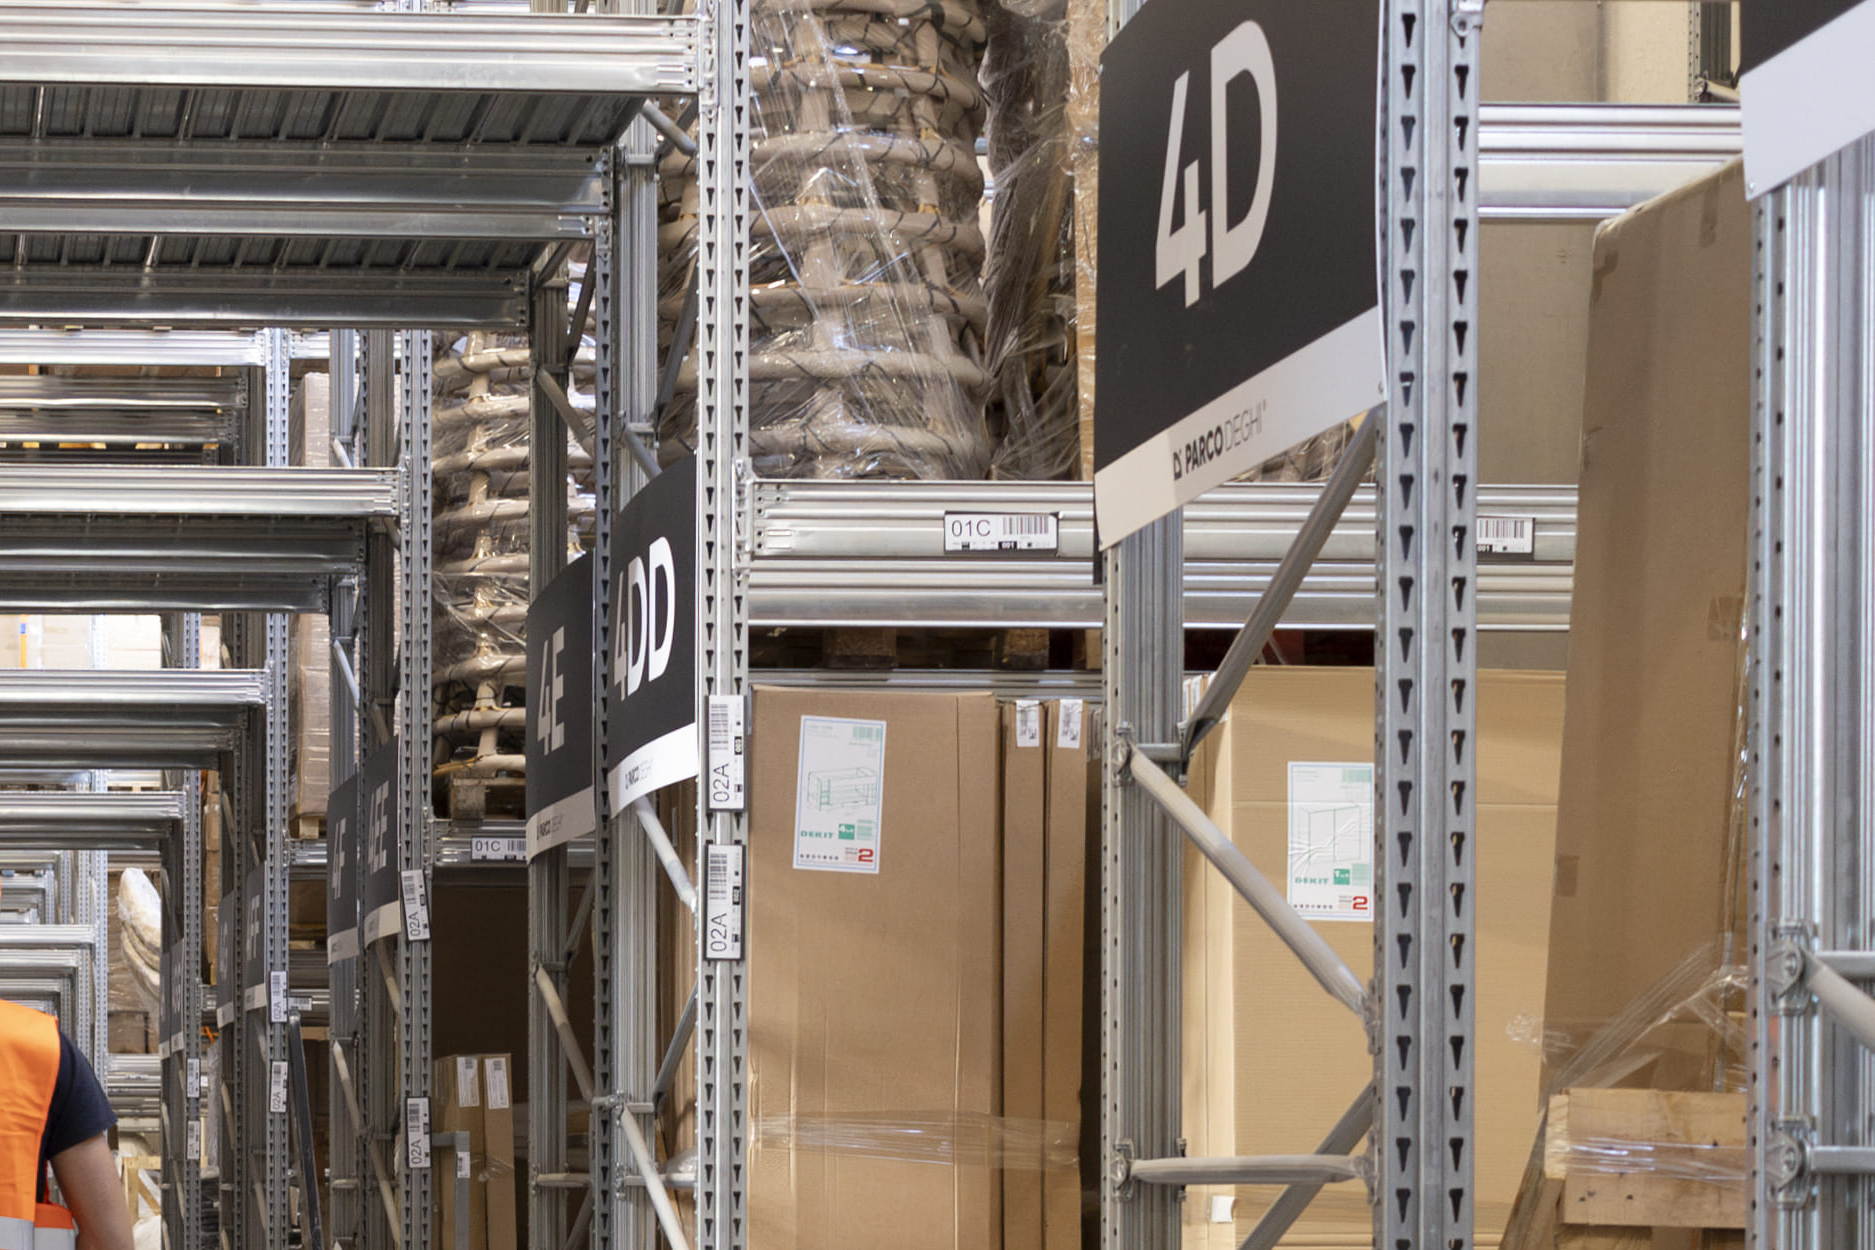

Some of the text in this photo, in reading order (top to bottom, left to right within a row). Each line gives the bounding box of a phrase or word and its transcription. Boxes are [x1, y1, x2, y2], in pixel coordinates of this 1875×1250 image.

[1155, 19, 1278, 309] 4D
[951, 519, 991, 537] 01C
[614, 536, 675, 701] 4DD
[537, 625, 565, 756] 4E
[713, 763, 730, 802] 02A
[475, 840, 501, 852] 01C
[858, 848, 874, 863] 2
[1352, 895, 1368, 910] 2
[408, 911, 421, 937] 02A
[711, 912, 728, 952] 02A
[411, 1139, 422, 1165] 02A
